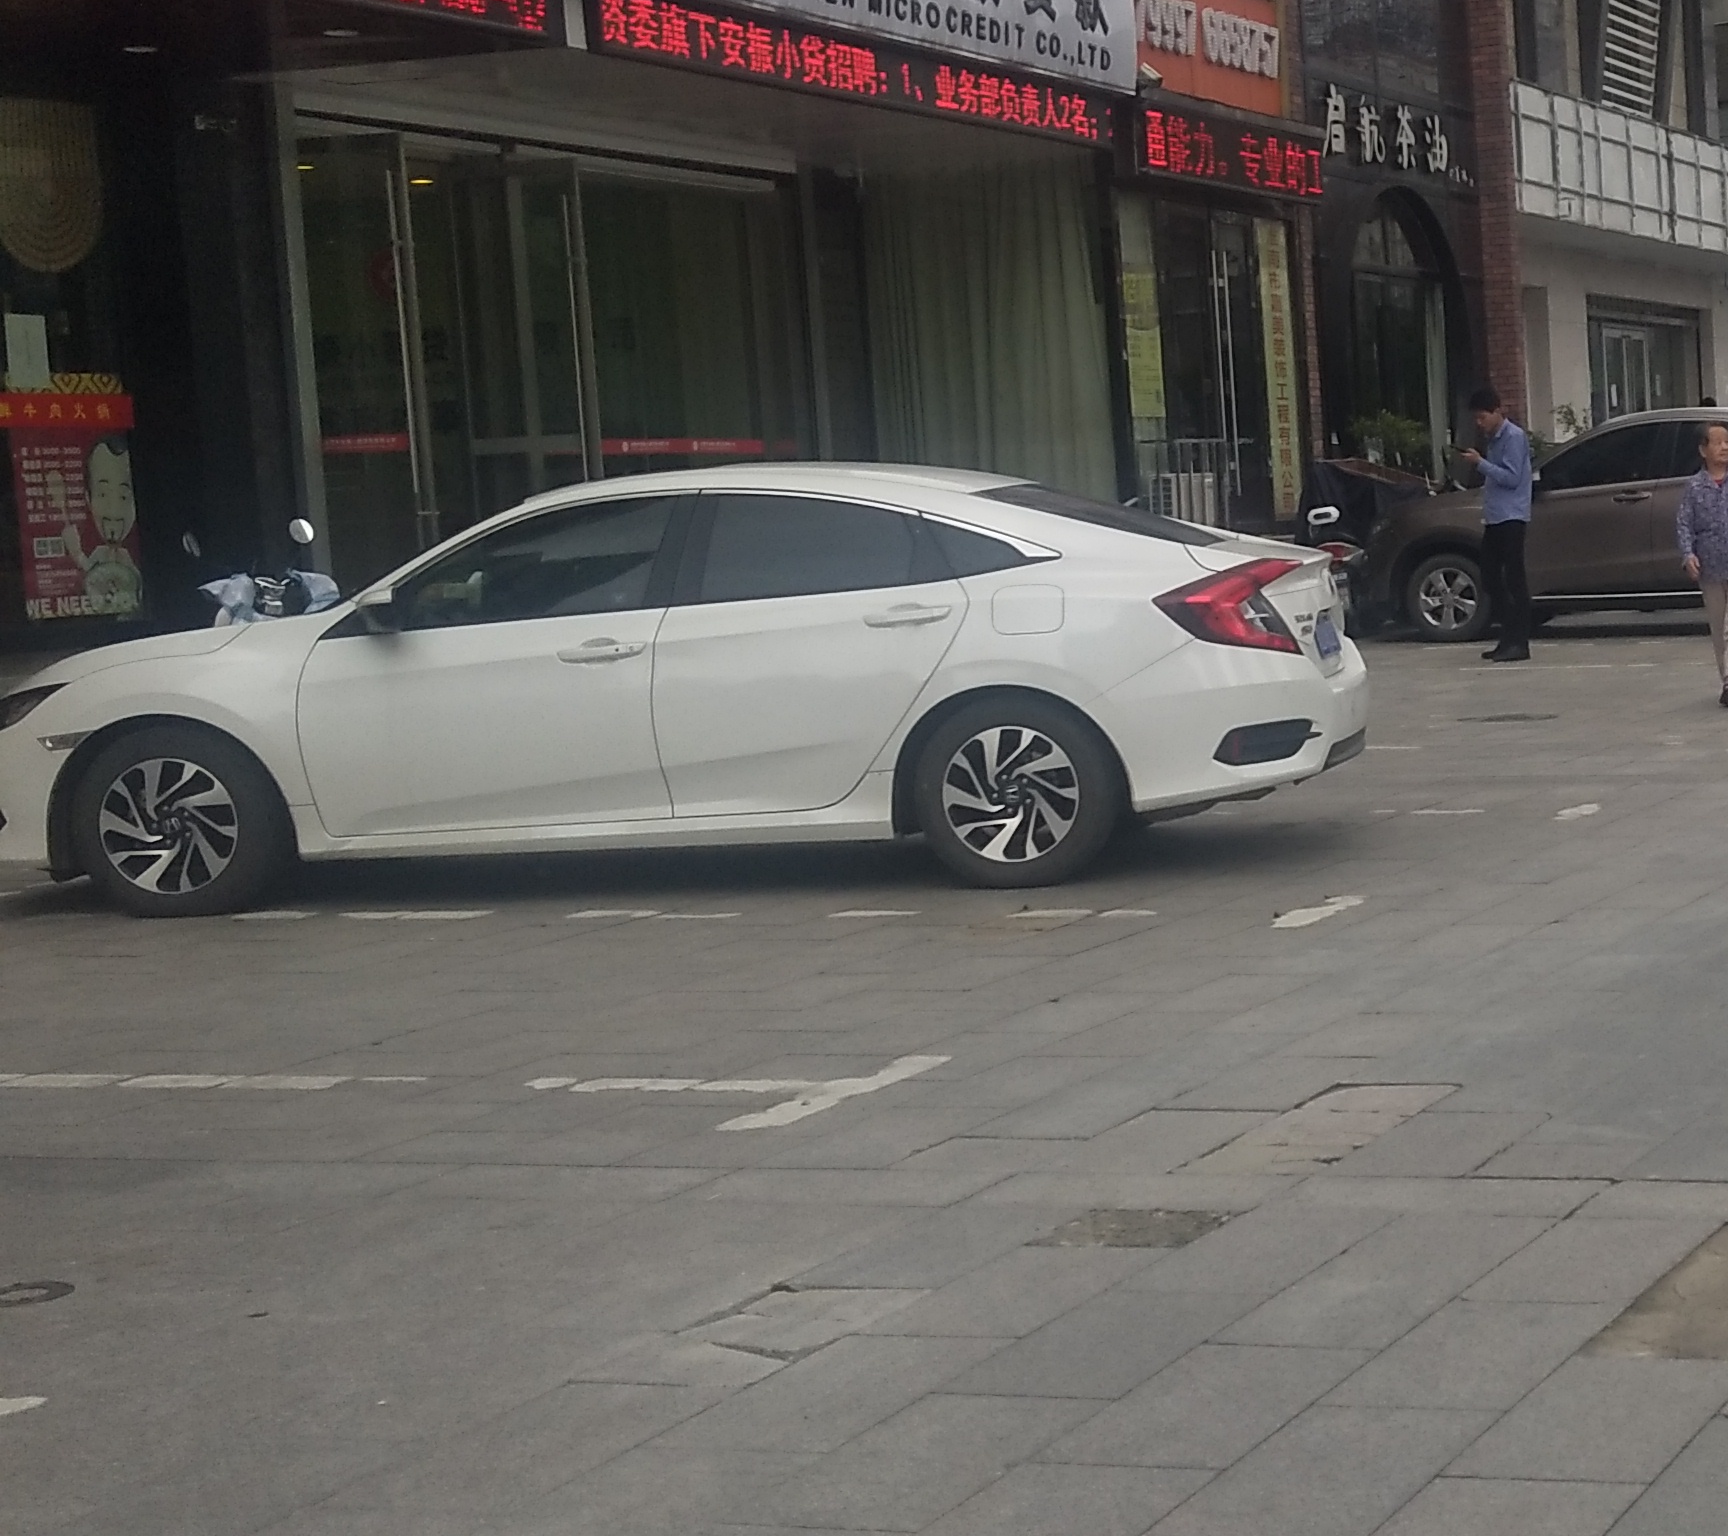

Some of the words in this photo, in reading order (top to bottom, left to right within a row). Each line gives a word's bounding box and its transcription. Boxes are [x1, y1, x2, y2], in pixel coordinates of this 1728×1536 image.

[1035, 29, 1112, 72] CO.,LTD
[1323, 83, 1448, 173] 启航茶油
